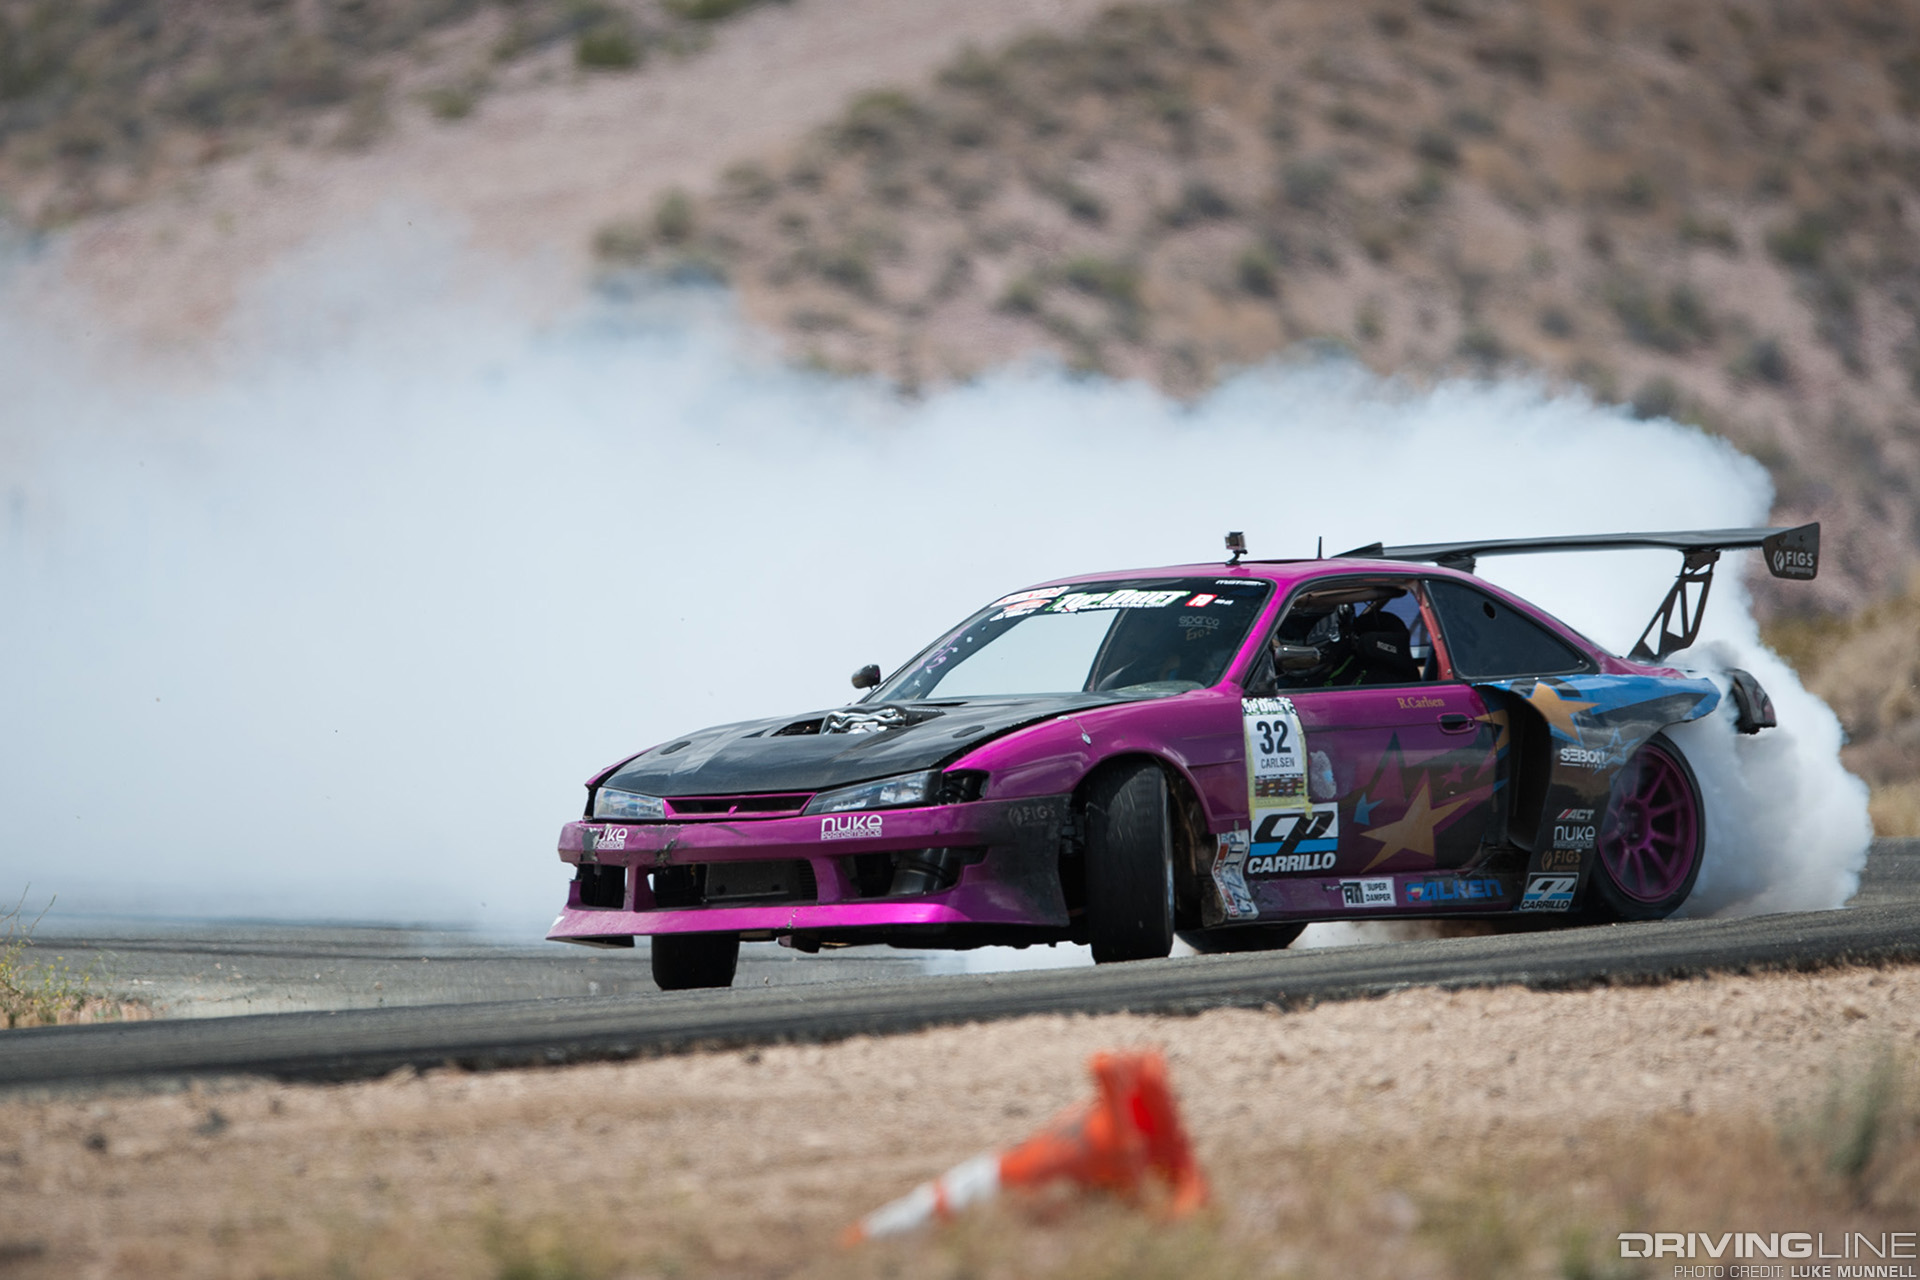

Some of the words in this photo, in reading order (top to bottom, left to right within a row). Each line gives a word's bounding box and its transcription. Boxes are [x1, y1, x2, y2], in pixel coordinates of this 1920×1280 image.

[1785, 551, 1814, 567] FIGS
[1256, 720, 1291, 755] 32
[1261, 757, 1295, 769] CARLSEN
[821, 814, 883, 832] nuke
[1554, 825, 1596, 841] nuke
[1247, 852, 1337, 875] CARRILLO
[1554, 850, 1582, 863] FIGS
[1366, 882, 1388, 892] SUPER
[1406, 879, 1504, 903] FALKEN
[1365, 893, 1392, 902] DAMPER
[1520, 900, 1570, 910] CARRILLO
